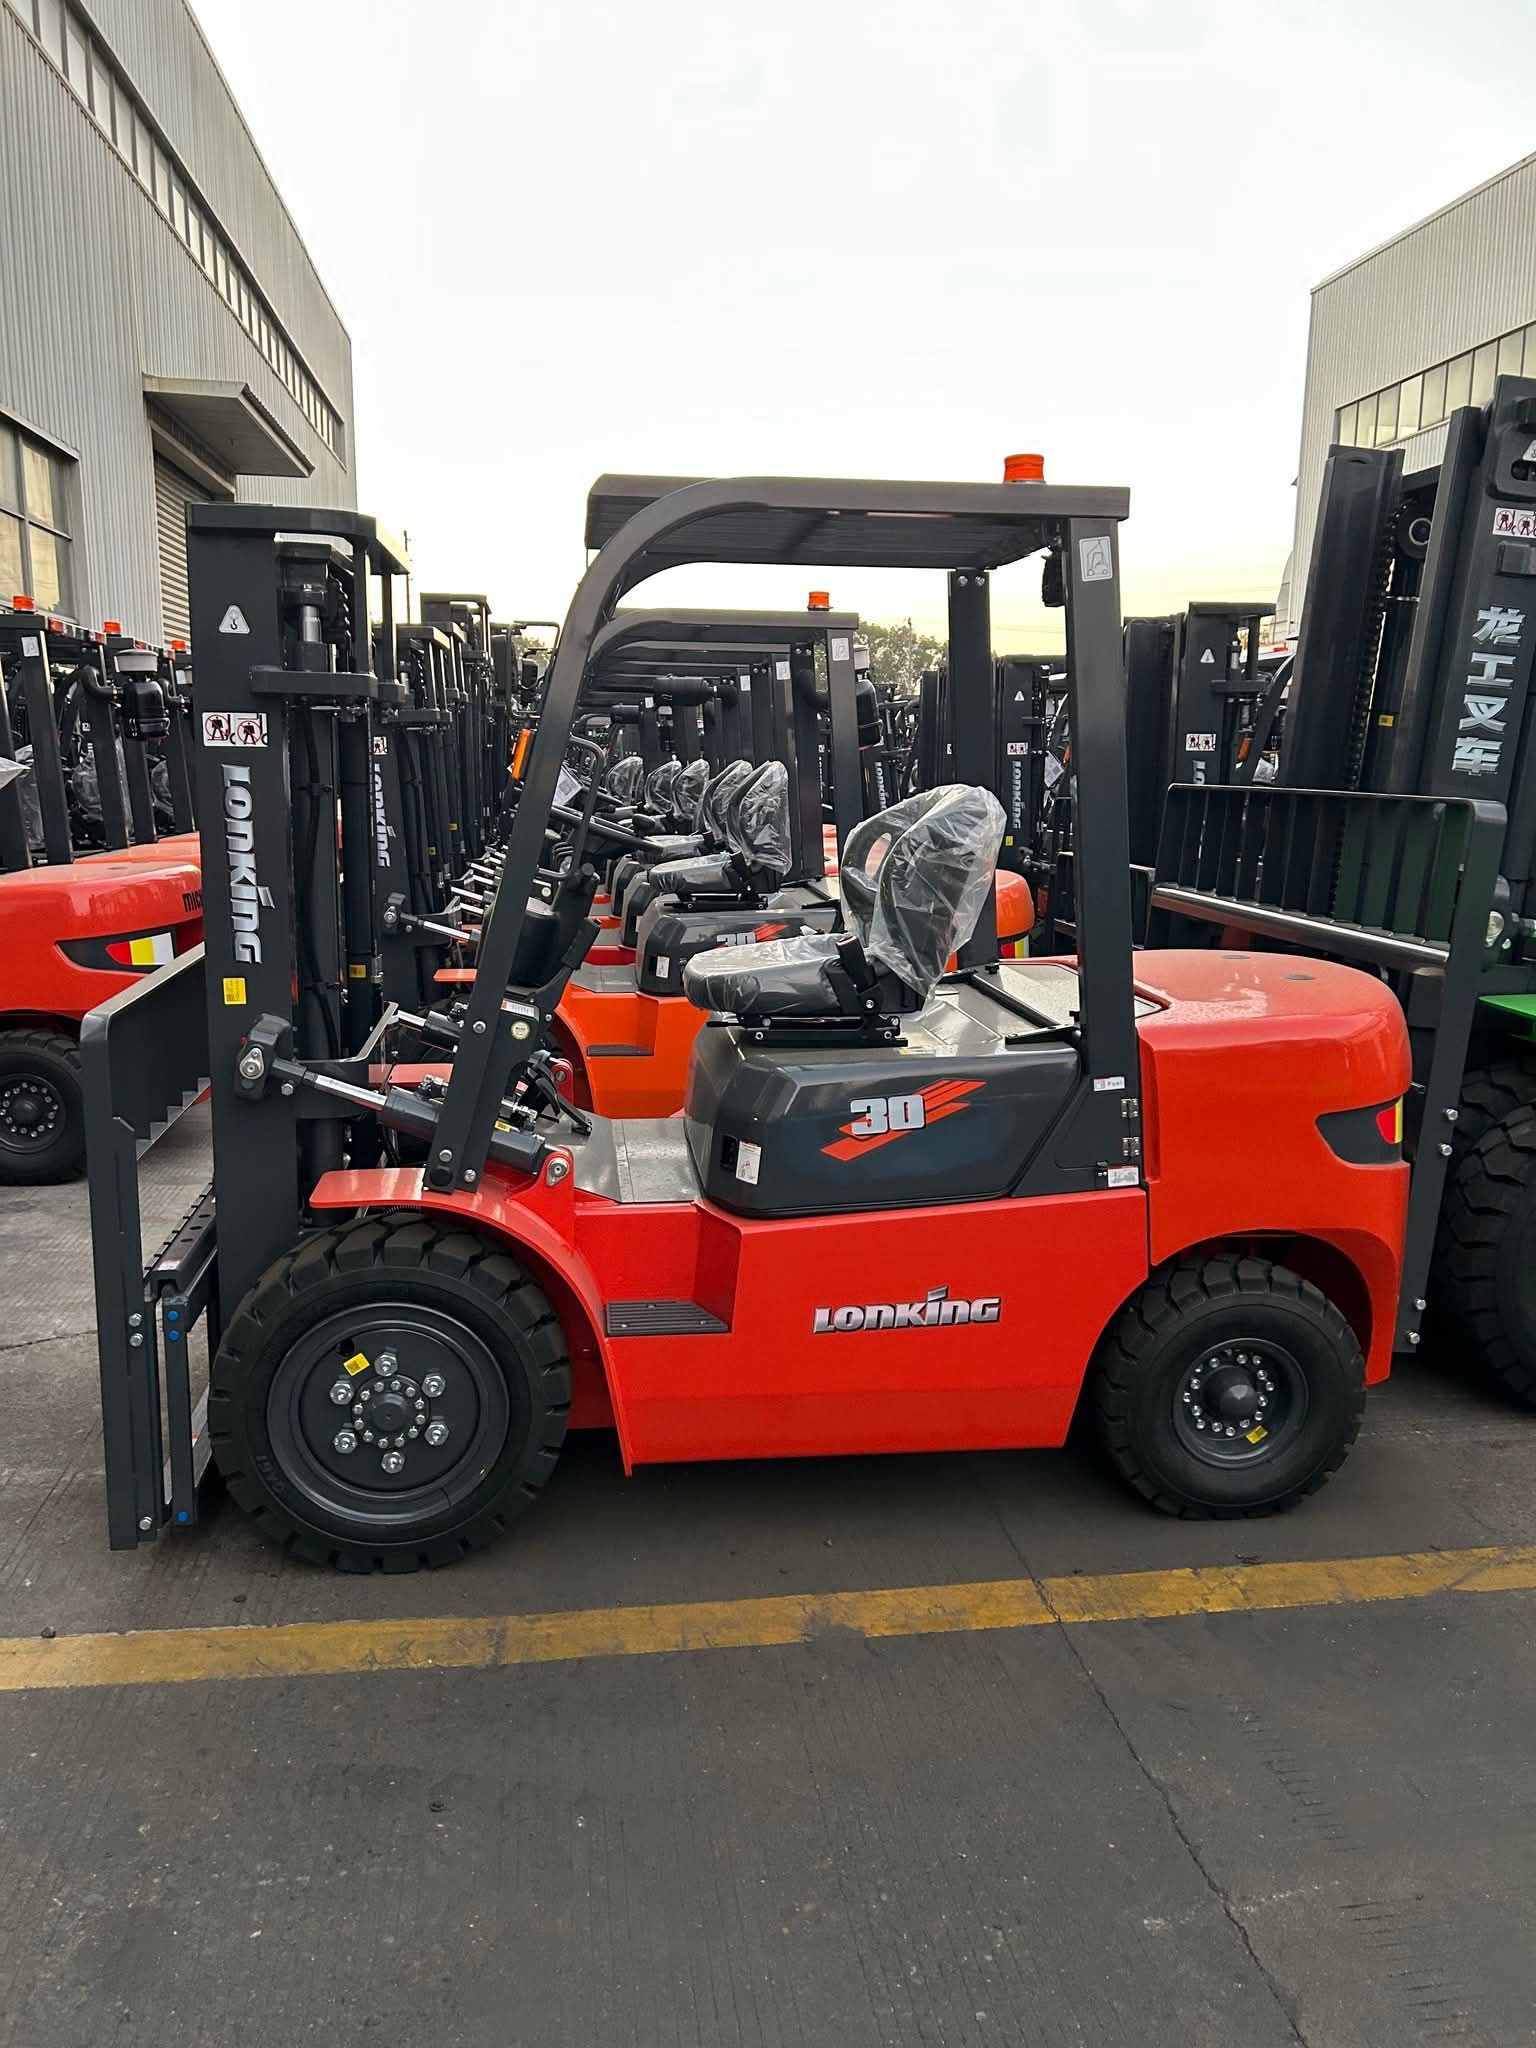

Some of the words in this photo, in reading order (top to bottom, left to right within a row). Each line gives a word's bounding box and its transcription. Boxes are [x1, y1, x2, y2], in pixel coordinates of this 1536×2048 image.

[1451, 605, 1526, 777] 龙工叉车
[849, 1093, 926, 1136] 30
